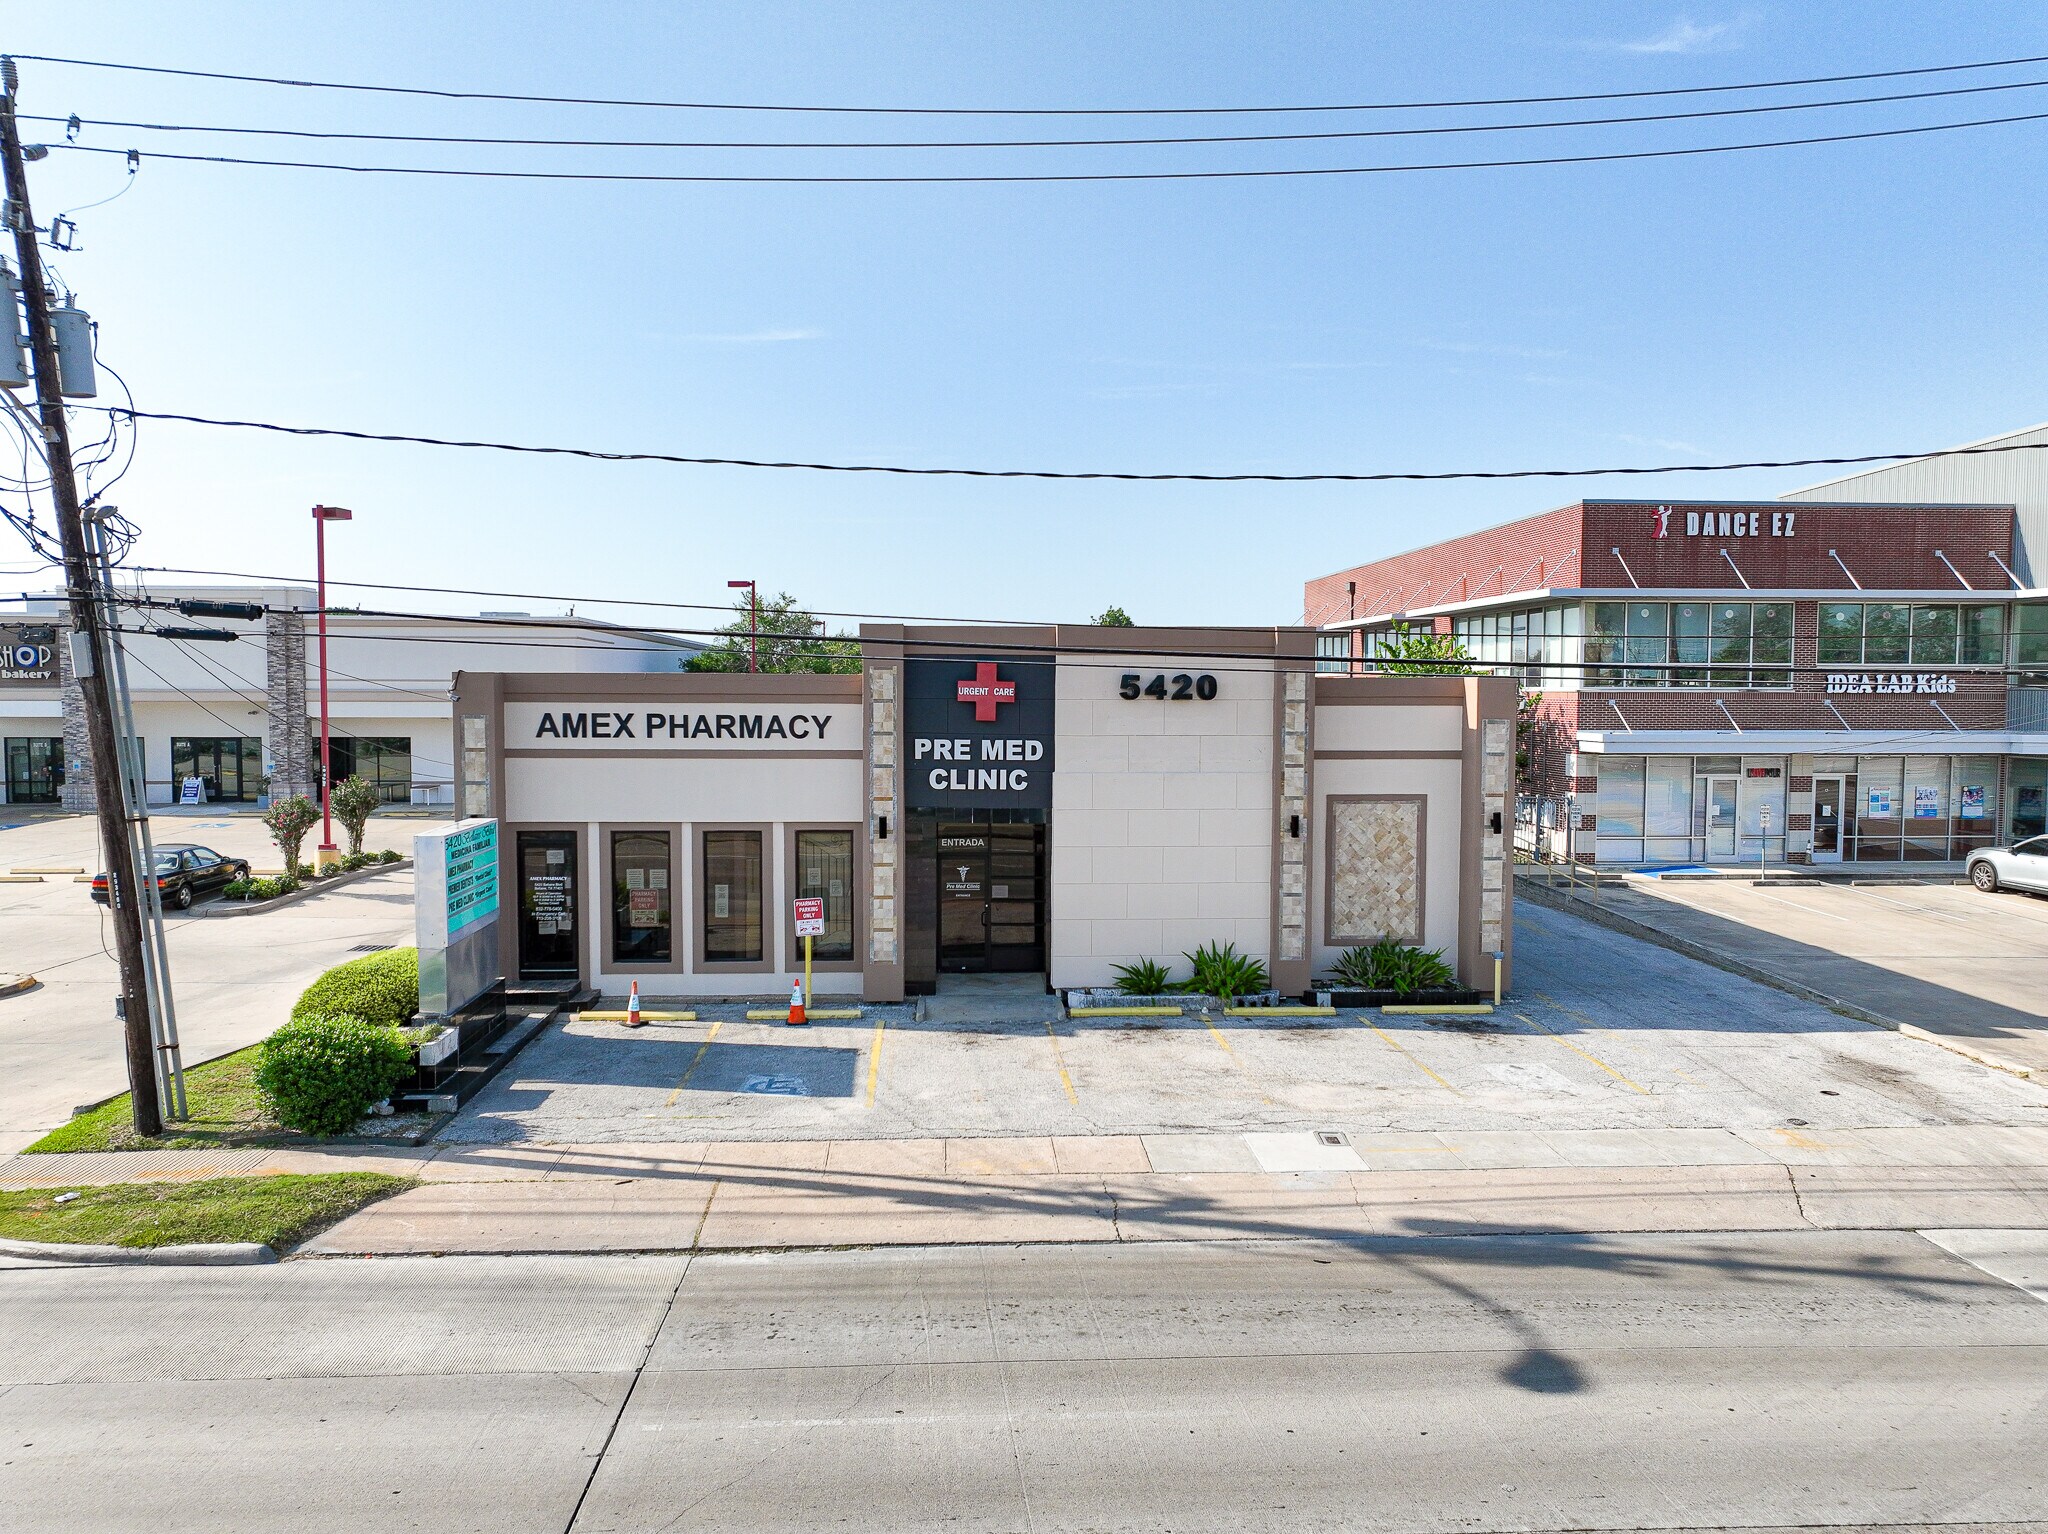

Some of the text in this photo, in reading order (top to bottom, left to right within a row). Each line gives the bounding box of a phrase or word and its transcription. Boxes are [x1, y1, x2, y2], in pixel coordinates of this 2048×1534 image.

[1686, 512, 1795, 537] DANCE EZ
[1, 669, 52, 680] bakery
[1826, 673, 1956, 694] IDEA LAB Kids
[958, 687, 1015, 696] URGENT CARE
[1119, 674, 1218, 701] 5420
[535, 712, 833, 740] AMEX PHARMACY
[914, 738, 1044, 761] PRE MED
[928, 768, 1028, 791] CLINIC
[445, 833, 462, 851] 5420
[941, 838, 985, 847] ENTRADA
